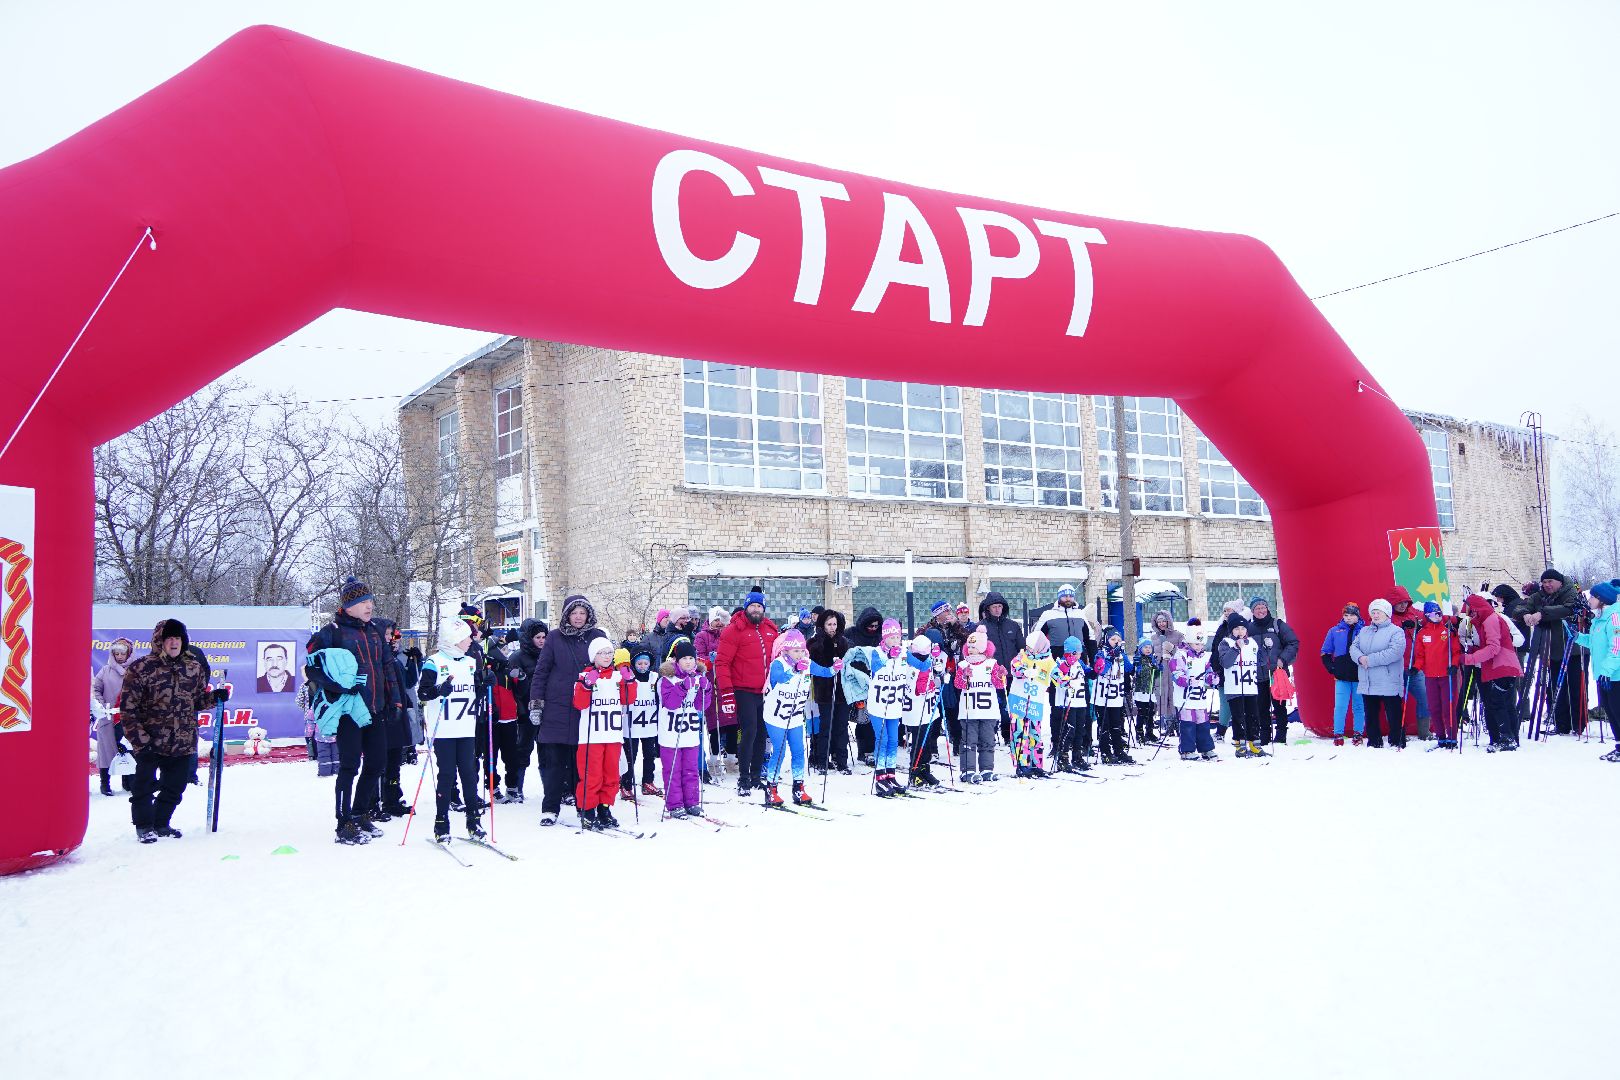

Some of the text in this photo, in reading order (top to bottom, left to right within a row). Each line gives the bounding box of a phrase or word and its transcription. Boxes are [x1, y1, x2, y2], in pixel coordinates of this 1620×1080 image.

[651, 149, 1108, 338] СТАРТ
[1023, 682, 1039, 697] 98
[440, 697, 478, 720] 174
[964, 692, 992, 710] 115
[591, 710, 622, 731] 110
[667, 711, 701, 733] 165
